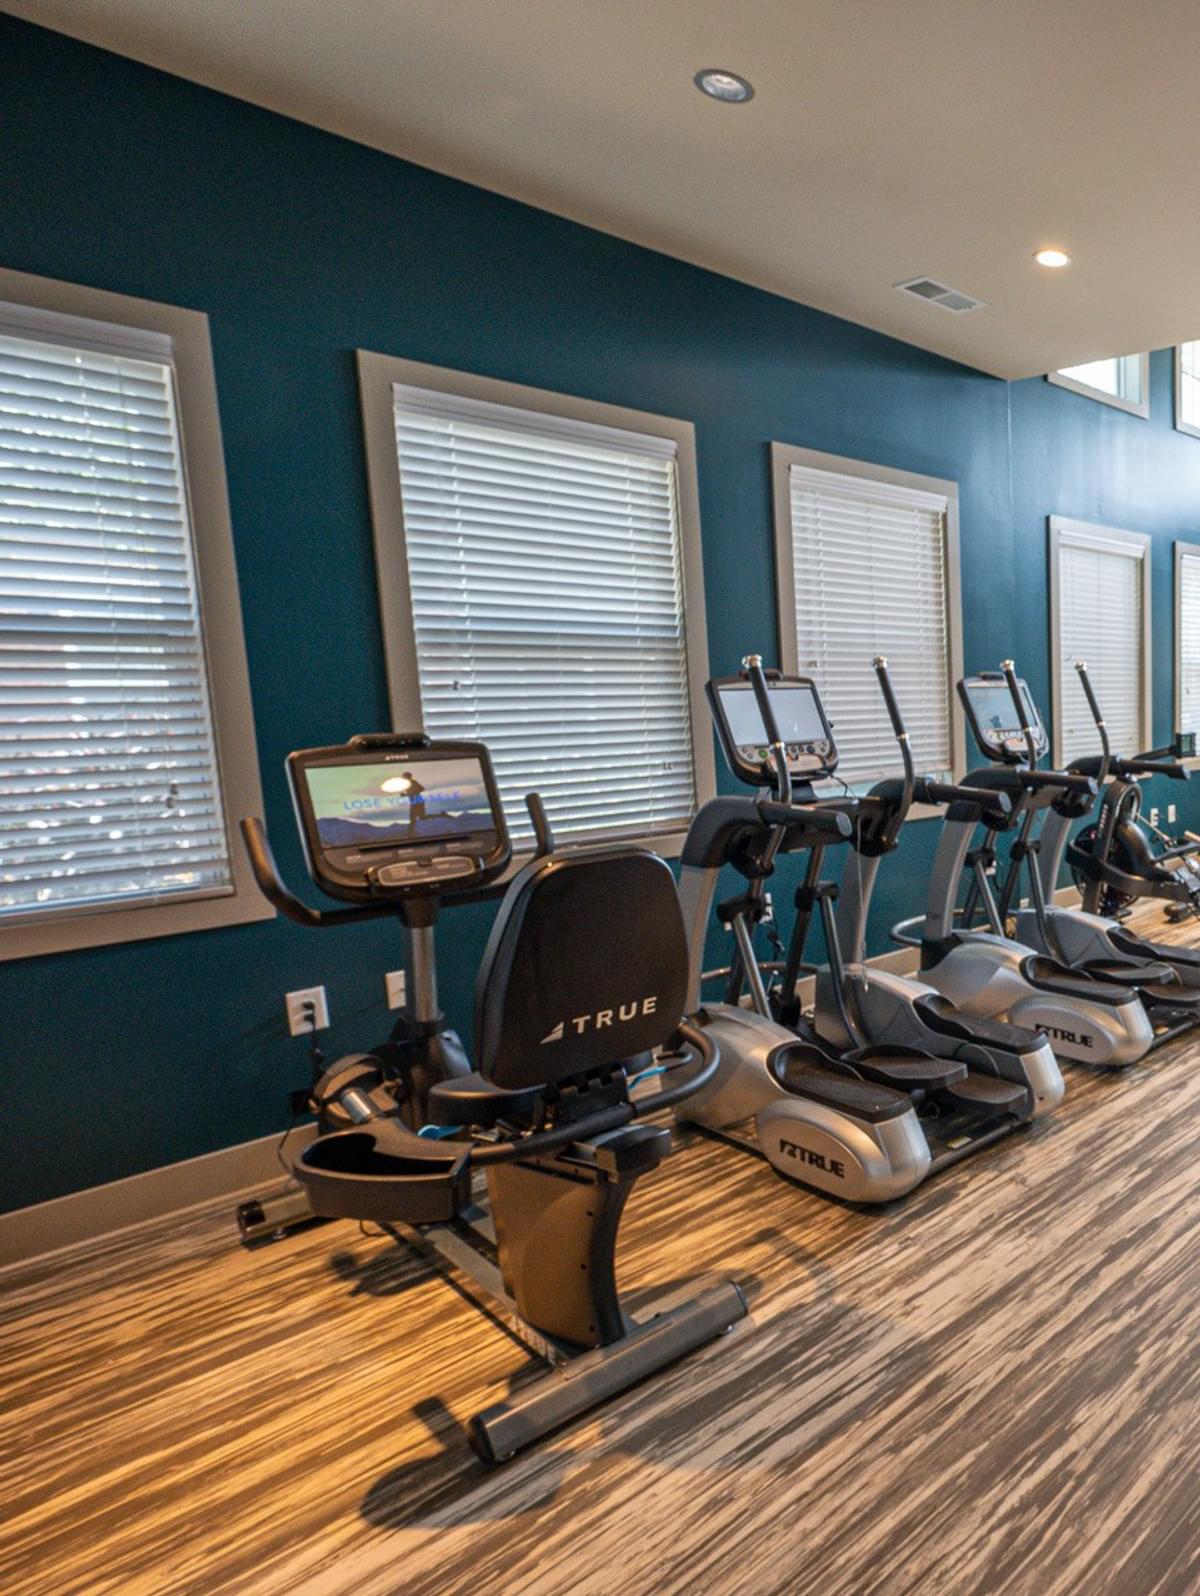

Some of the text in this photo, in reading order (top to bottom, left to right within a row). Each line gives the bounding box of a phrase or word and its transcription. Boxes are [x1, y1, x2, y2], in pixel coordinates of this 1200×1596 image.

[343, 797, 381, 810] LOSE
[572, 996, 657, 1034] TRUE
[1051, 1027, 1093, 1048] TRUE
[797, 1145, 845, 1179] TRUE
